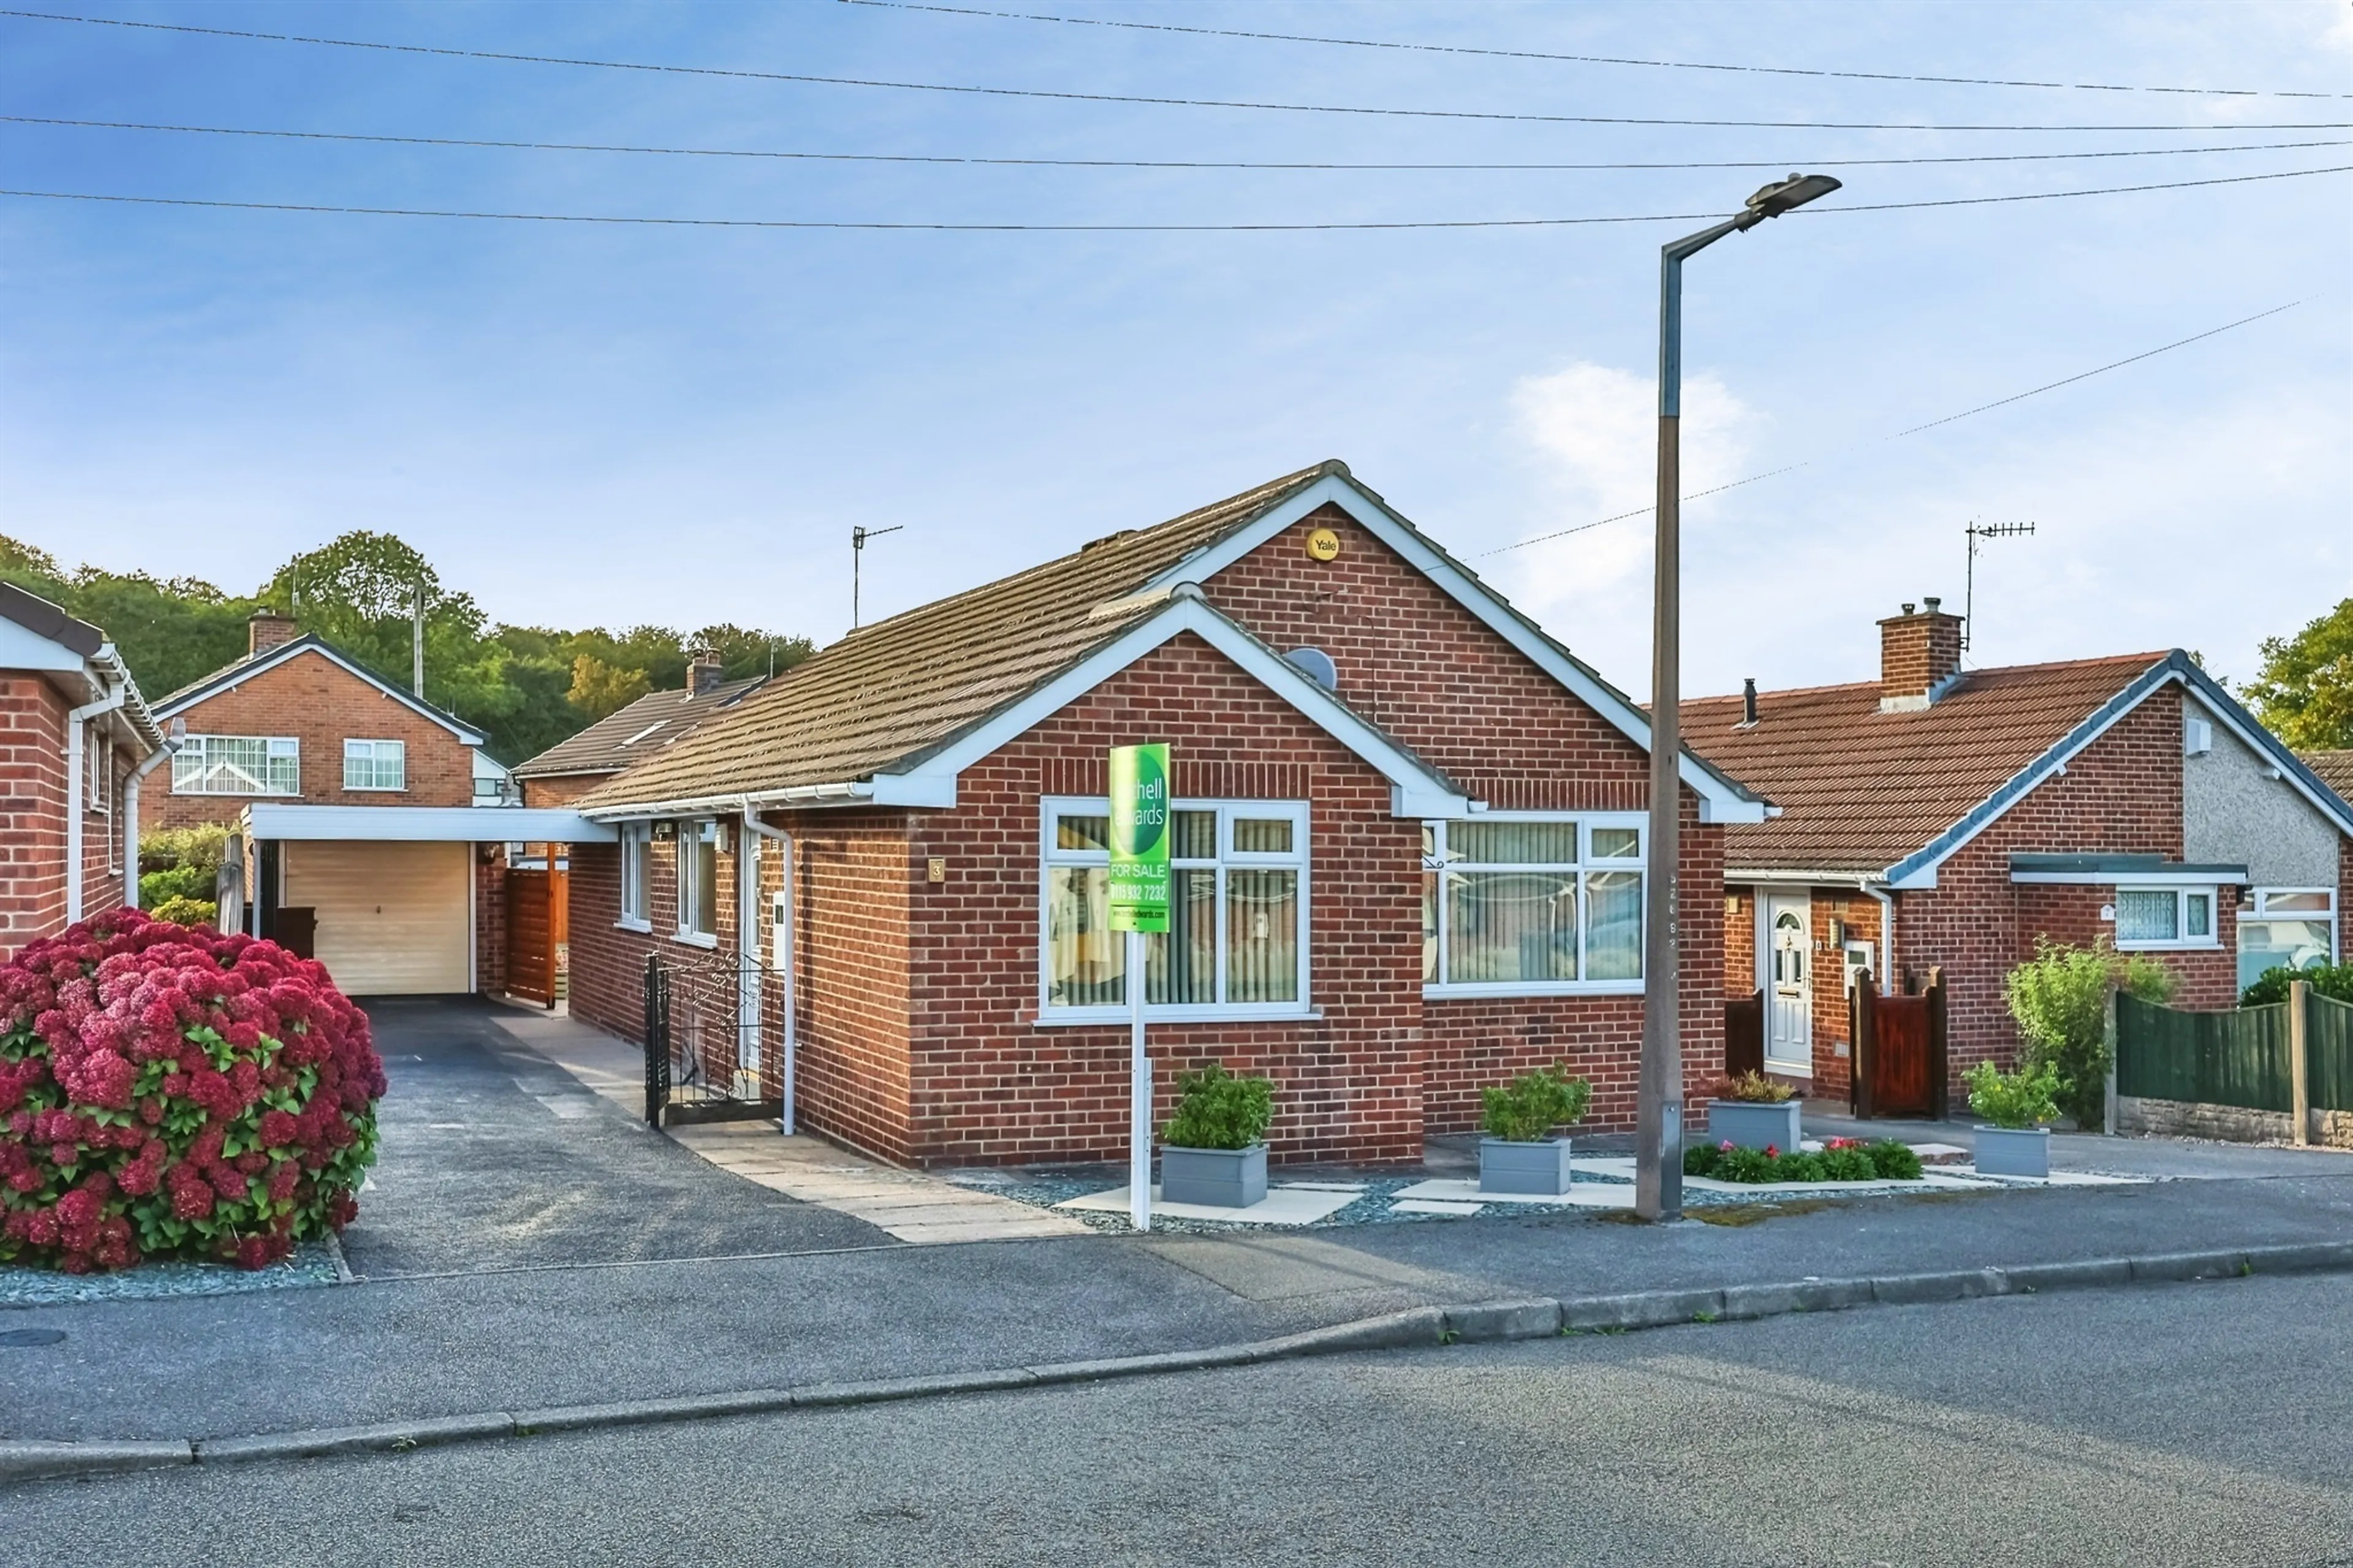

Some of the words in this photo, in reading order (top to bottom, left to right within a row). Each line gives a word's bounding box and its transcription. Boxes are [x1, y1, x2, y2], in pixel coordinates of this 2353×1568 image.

[1315, 539, 1337, 551] Yale
[933, 866, 941, 876] 3
[1110, 864, 1130, 877] FOR
[1132, 864, 1165, 877] SALE
[1144, 884, 1165, 901] 7232
